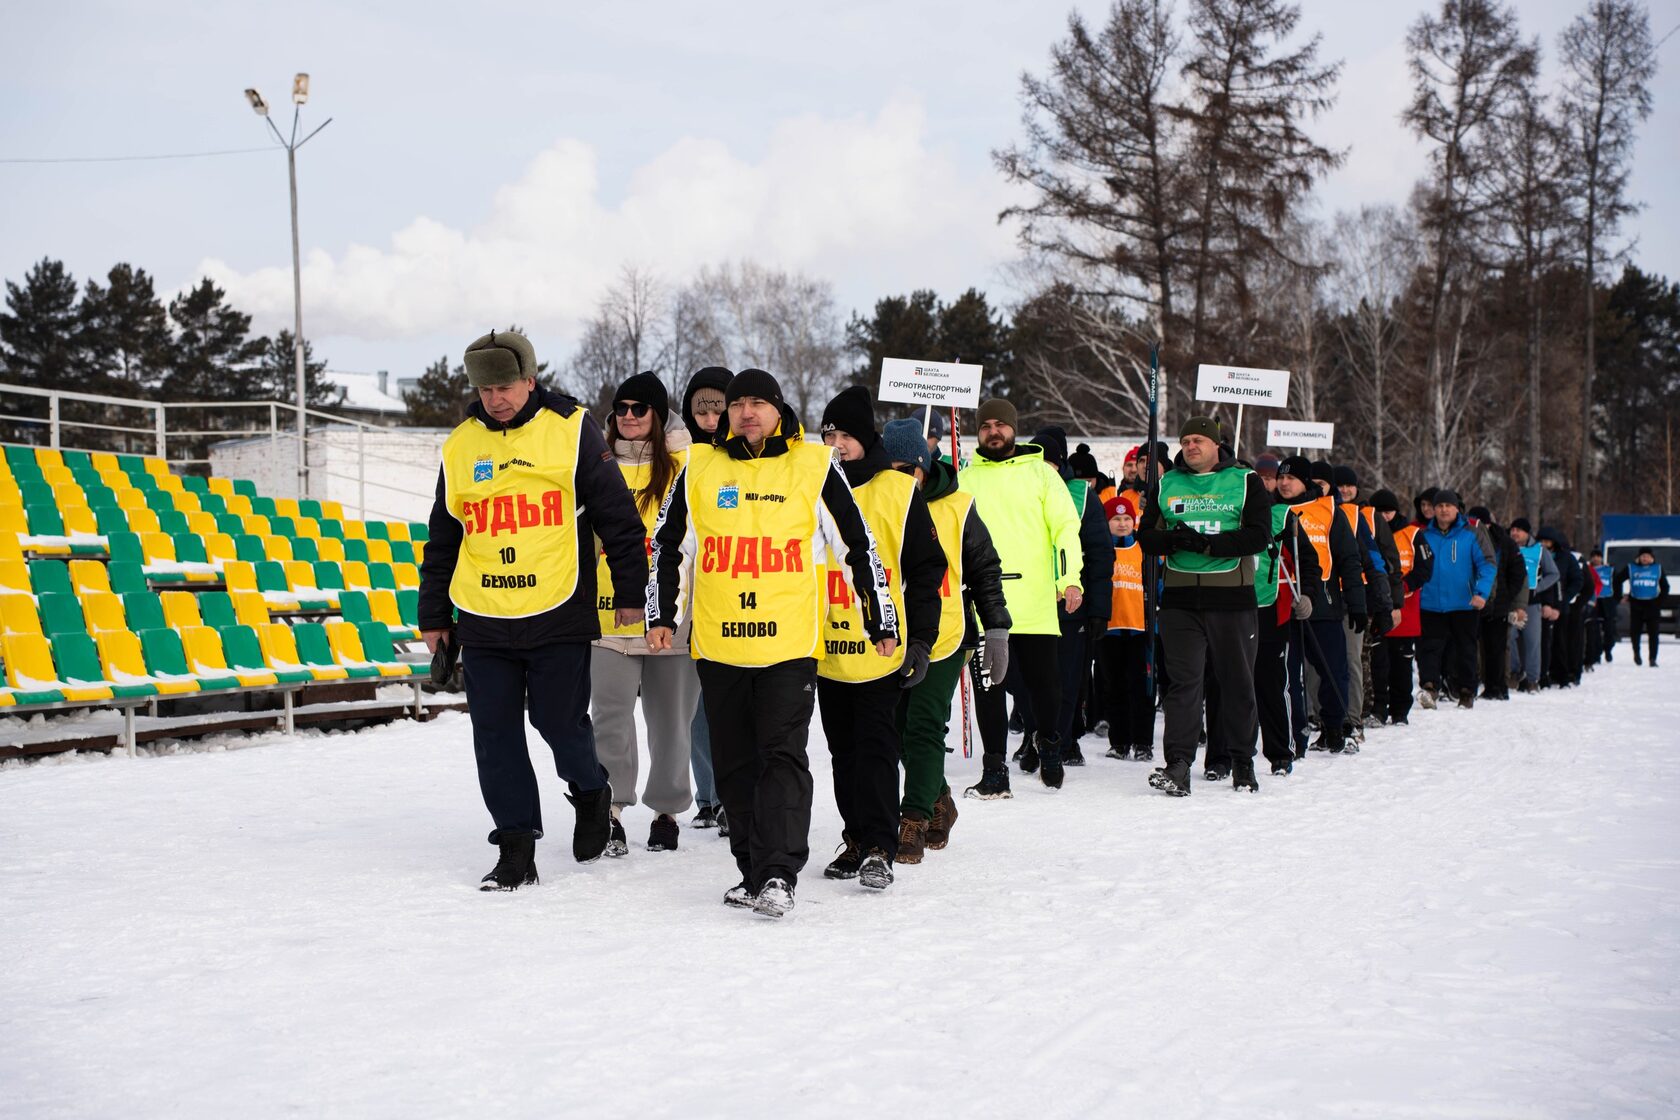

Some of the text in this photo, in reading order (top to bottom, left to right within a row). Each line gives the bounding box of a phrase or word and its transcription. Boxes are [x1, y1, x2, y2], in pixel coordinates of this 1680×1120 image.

[889, 380, 972, 394] ГОРНОТРАНСПОРТНЫЙ
[1212, 385, 1273, 398] УПРАВЛЕНИЕ
[912, 391, 946, 400] УЧАСТОК
[1282, 431, 1327, 439] БЕЛКОММЕРЦ
[745, 492, 759, 501] МАУ
[463, 490, 563, 537] СУДЬЯ
[1184, 504, 1234, 512] БЕЛОВСКАЯ
[1183, 520, 1221, 535] ТУ
[498, 546, 516, 565] 10
[702, 536, 804, 579] СУДЬЯ
[481, 573, 537, 589] БЕЛОВО
[738, 591, 757, 610] 14
[721, 621, 778, 638] БЕЛОВО
[825, 640, 866, 655] ЕЛОВО
